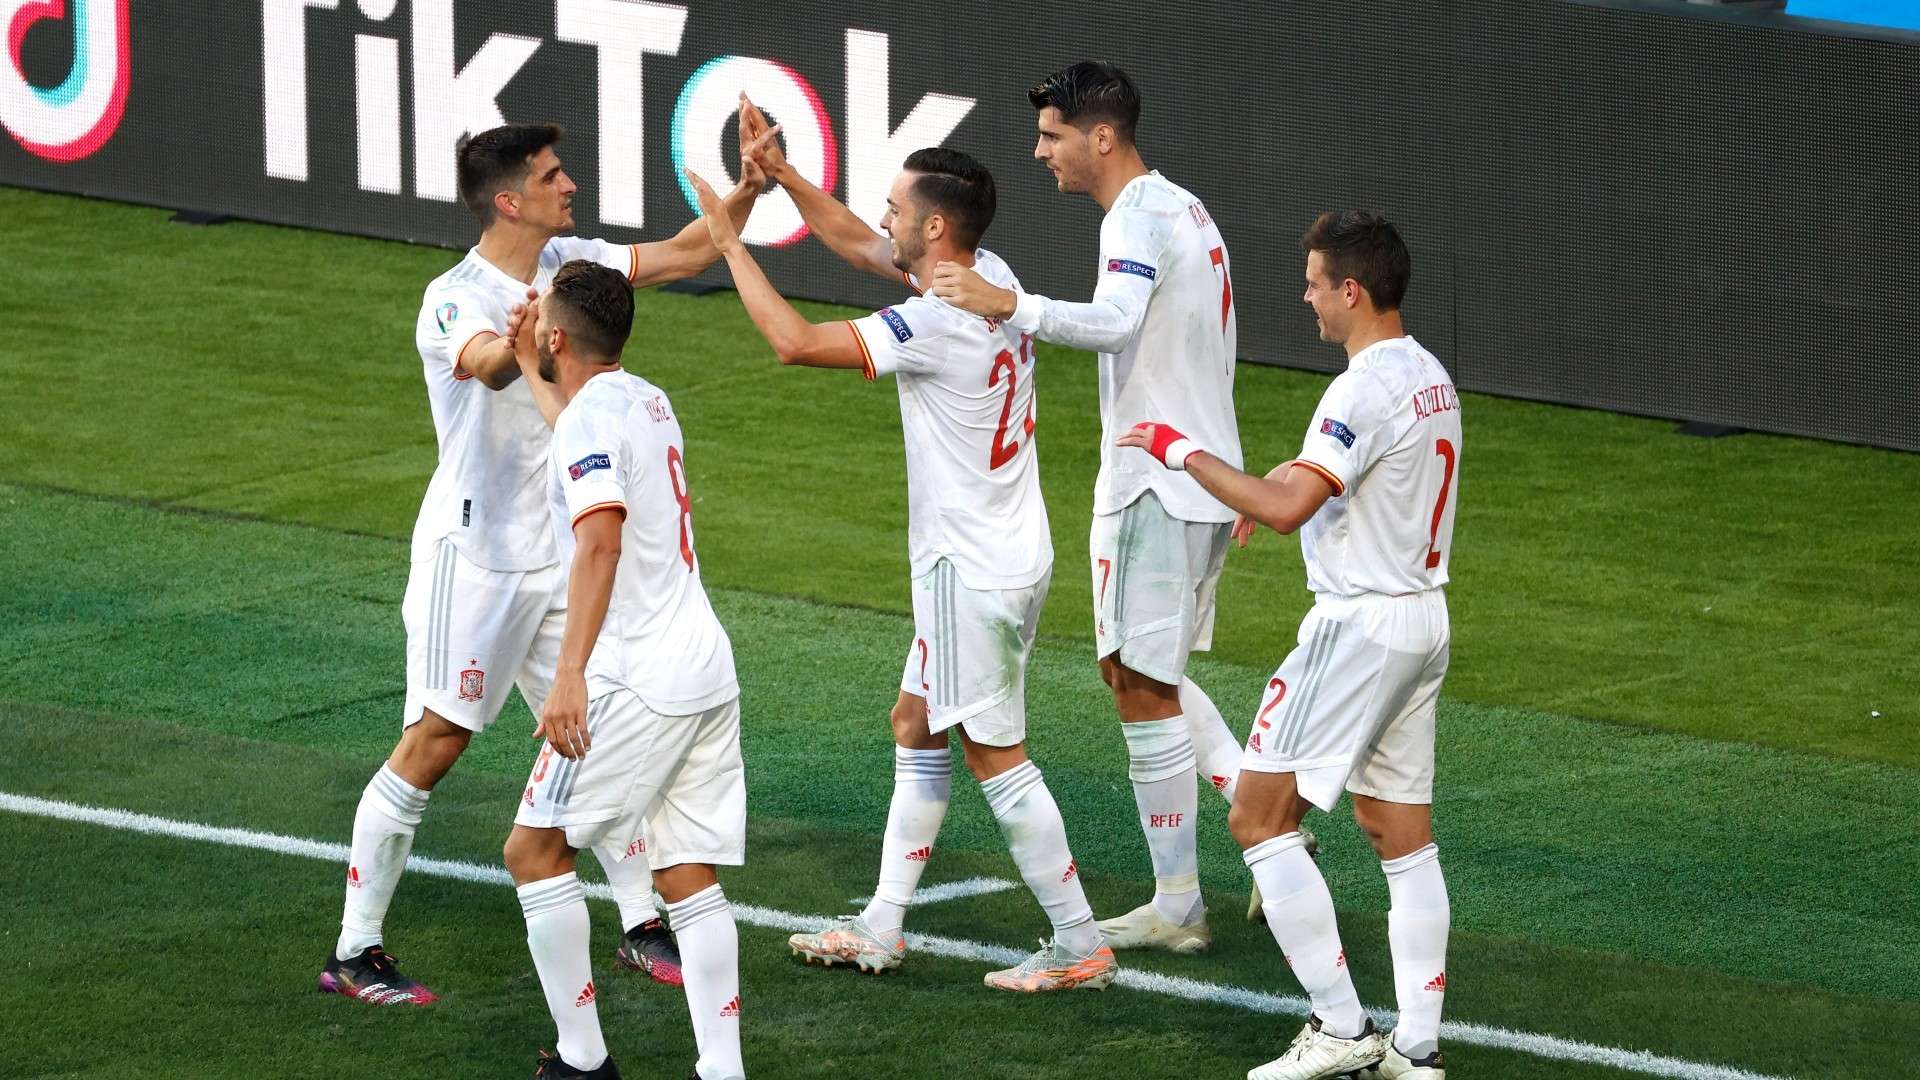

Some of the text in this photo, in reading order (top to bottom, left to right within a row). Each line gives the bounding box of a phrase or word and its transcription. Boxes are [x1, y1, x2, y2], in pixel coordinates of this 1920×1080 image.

[262, 0, 977, 247] TikTok
[1122, 263, 1155, 277] RESPECT
[887, 312, 909, 341] RESPECT
[580, 457, 609, 471] RESPECT
[667, 445, 693, 573] 8
[1426, 438, 1456, 570] 2
[1098, 559, 1110, 609] 7
[1258, 677, 1286, 730] 2
[1150, 813, 1184, 828] RFEF
